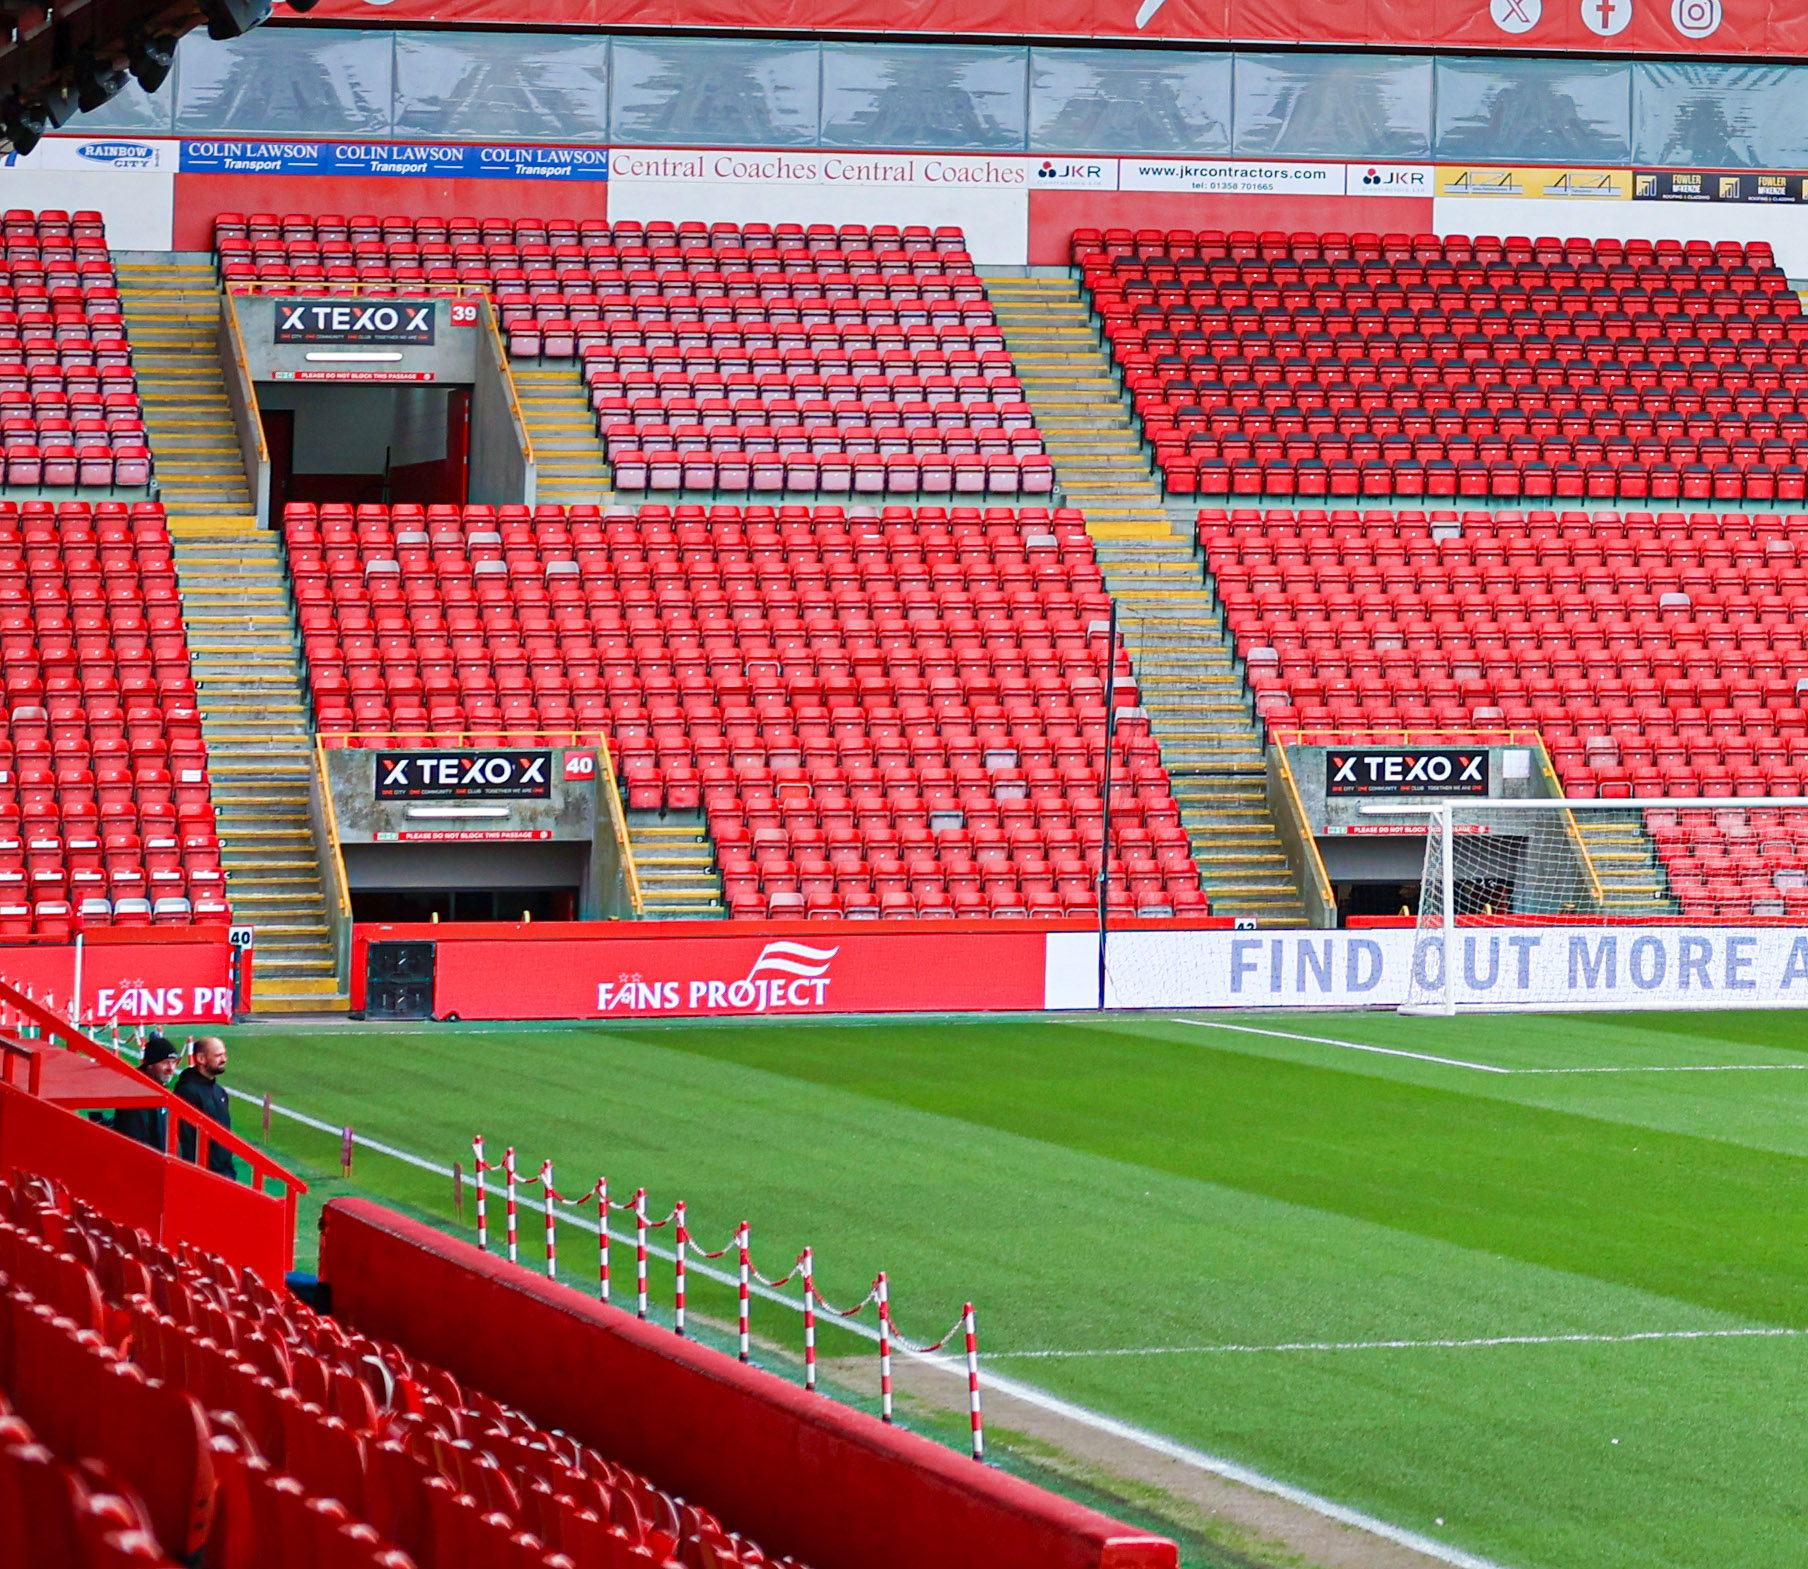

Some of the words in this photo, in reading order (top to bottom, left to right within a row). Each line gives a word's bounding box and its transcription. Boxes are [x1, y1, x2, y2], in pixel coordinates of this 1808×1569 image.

[85, 146, 148, 158] RAINBOW
[188, 142, 242, 156] COLIN
[246, 144, 318, 158] LAWSON
[335, 146, 389, 160] COLIN
[393, 147, 464, 161] LAWSON
[480, 149, 534, 163] COLIN
[538, 150, 607, 164] LAWSON
[114, 159, 148, 168] CITY
[224, 158, 281, 170] Transport
[370, 161, 427, 173] Transport
[515, 164, 571, 176] Transport
[612, 155, 705, 178] Central
[714, 157, 816, 180] Coaches
[824, 159, 915, 182] Central
[924, 161, 1024, 184] Coaches
[1059, 165, 1101, 179] JKR
[1138, 165, 1326, 180] www.jkrcontractors.com
[1383, 171, 1424, 185] JKR
[1192, 182, 1207, 190] tel:
[1210, 182, 1239, 190] 01358
[1241, 183, 1274, 191] 701665
[1672, 175, 1701, 184] FOWLER
[1758, 177, 1786, 186] FOWLER
[281, 306, 305, 330] X
[312, 307, 399, 331] TEXO
[405, 308, 429, 331] X
[452, 306, 476, 321] 39
[383, 759, 409, 785] X
[416, 758, 512, 784] TEXO
[520, 758, 545, 783] X
[566, 757, 592, 773] 40
[1333, 756, 1357, 781] X
[1364, 756, 1451, 781] TEXO
[1458, 756, 1483, 781] X
[230, 930, 252, 947] 40
[1230, 938, 1384, 994] FIND
[1412, 935, 1542, 991] OUT
[1566, 935, 1757, 990] MORE
[97, 988, 184, 1017] FANS
[596, 981, 684, 1010] FANS
[688, 978, 832, 1012] PROJECT
